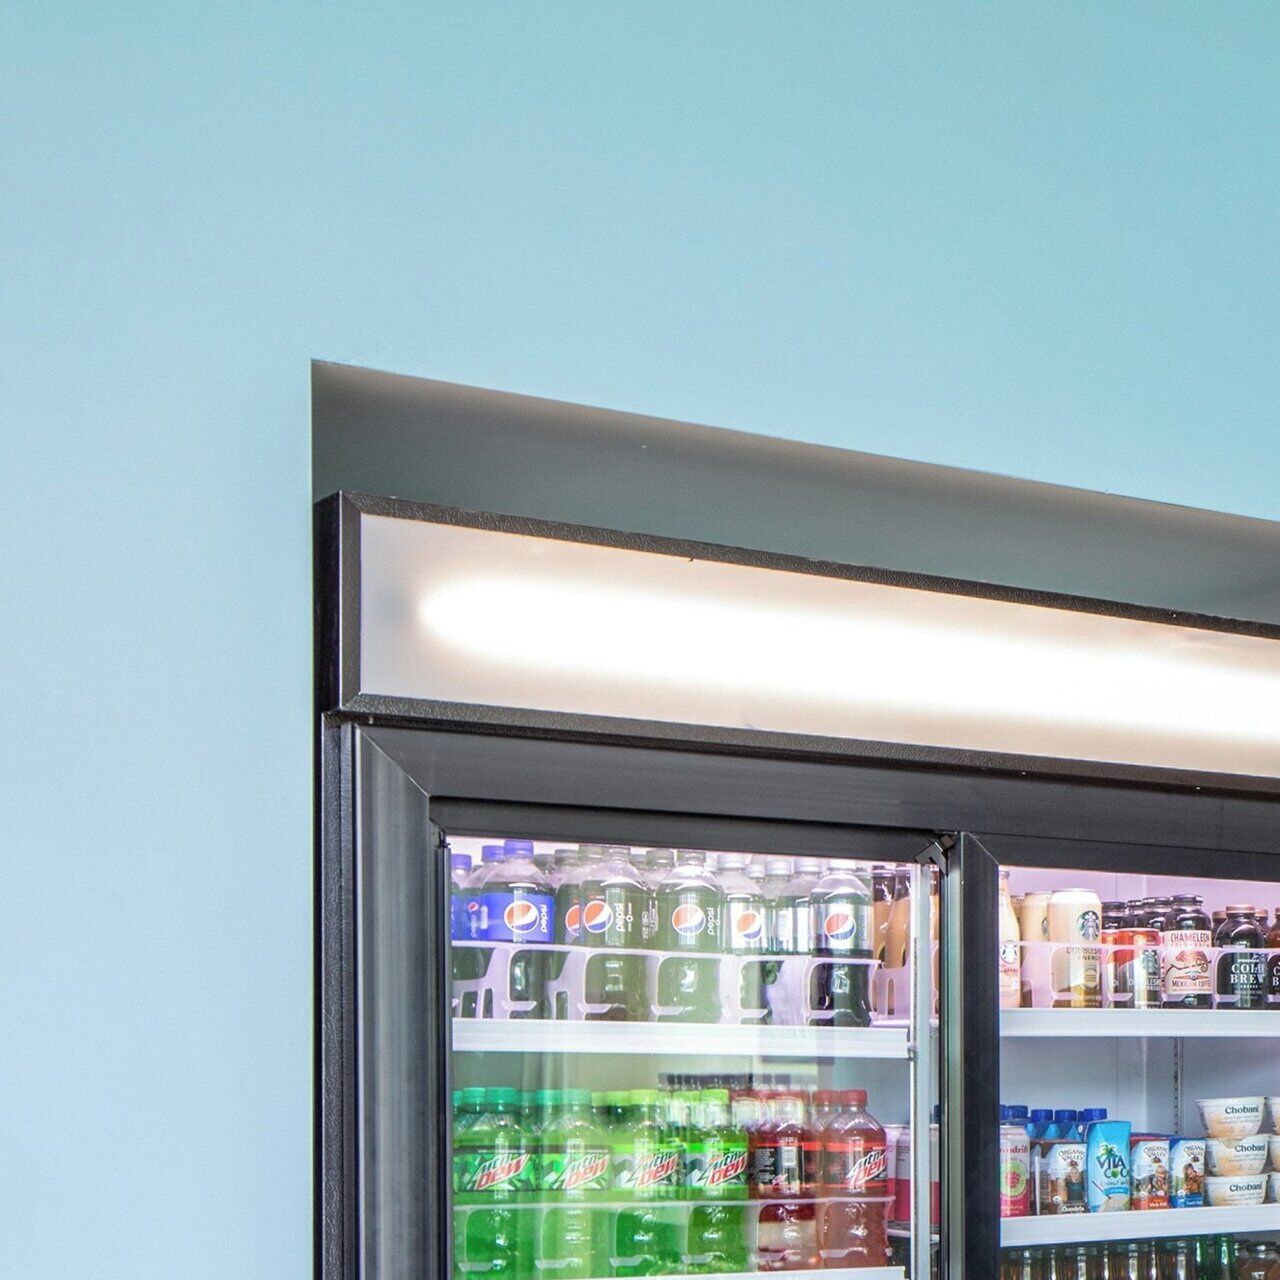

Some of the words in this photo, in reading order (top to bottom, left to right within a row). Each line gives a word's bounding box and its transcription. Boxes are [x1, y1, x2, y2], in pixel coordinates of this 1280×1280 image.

[540, 904, 548, 934] pepsi
[616, 902, 625, 932] pepsi
[1171, 933, 1210, 943] CHAMELEON
[1232, 963, 1265, 973] COLD
[1230, 973, 1265, 984] BREW
[1225, 1105, 1259, 1115] Chobani
[1235, 1144, 1265, 1152] Chobani
[1096, 1155, 1127, 1169] VITA
[1229, 1183, 1262, 1192] Chobani
